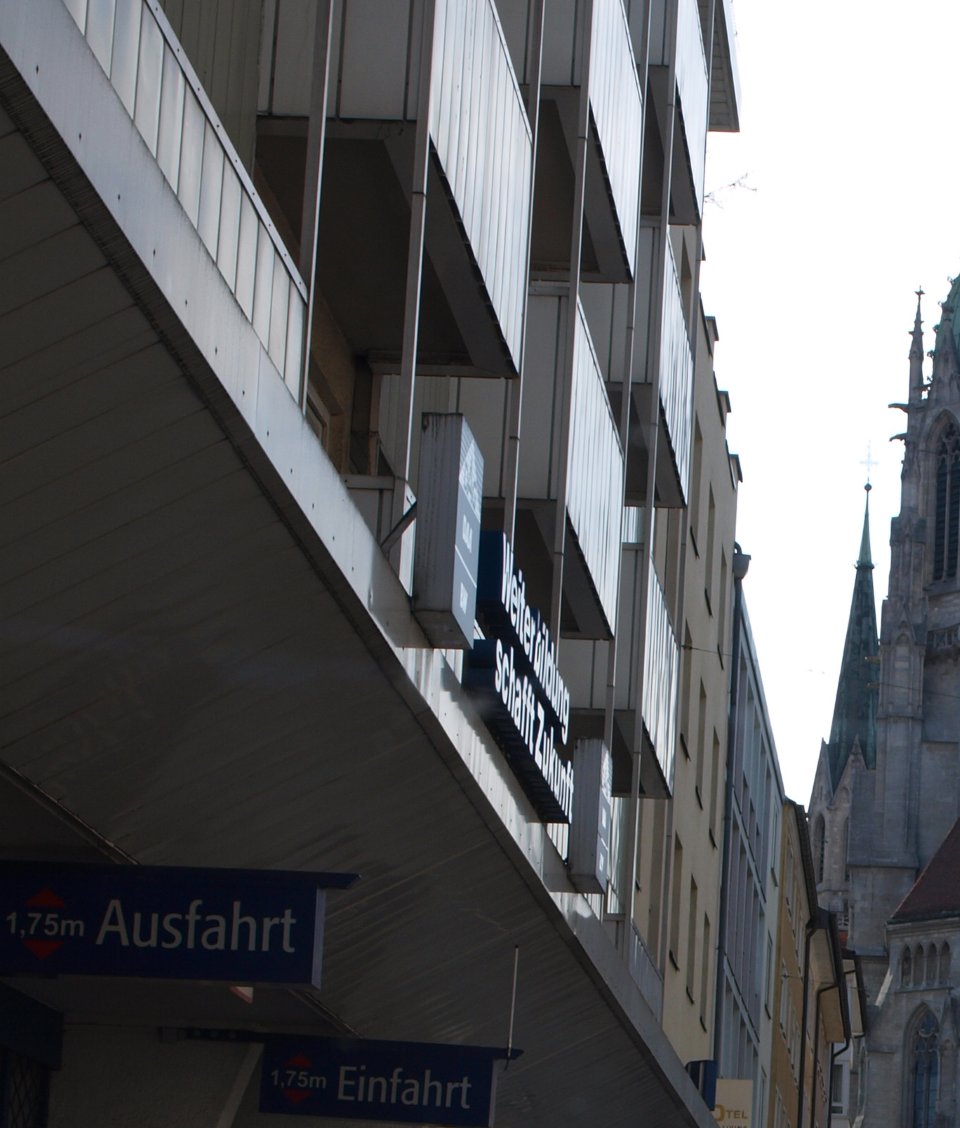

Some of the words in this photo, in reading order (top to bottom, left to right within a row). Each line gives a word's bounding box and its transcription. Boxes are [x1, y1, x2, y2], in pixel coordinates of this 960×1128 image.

[502, 531, 570, 745] Weiterbildung
[534, 702, 574, 824] Zukunft
[6, 912, 84, 938] 1,75m
[96, 899, 297, 953] Ausfahrt
[270, 1069, 327, 1090] 1,75m
[338, 1065, 472, 1110] Einfahrt
